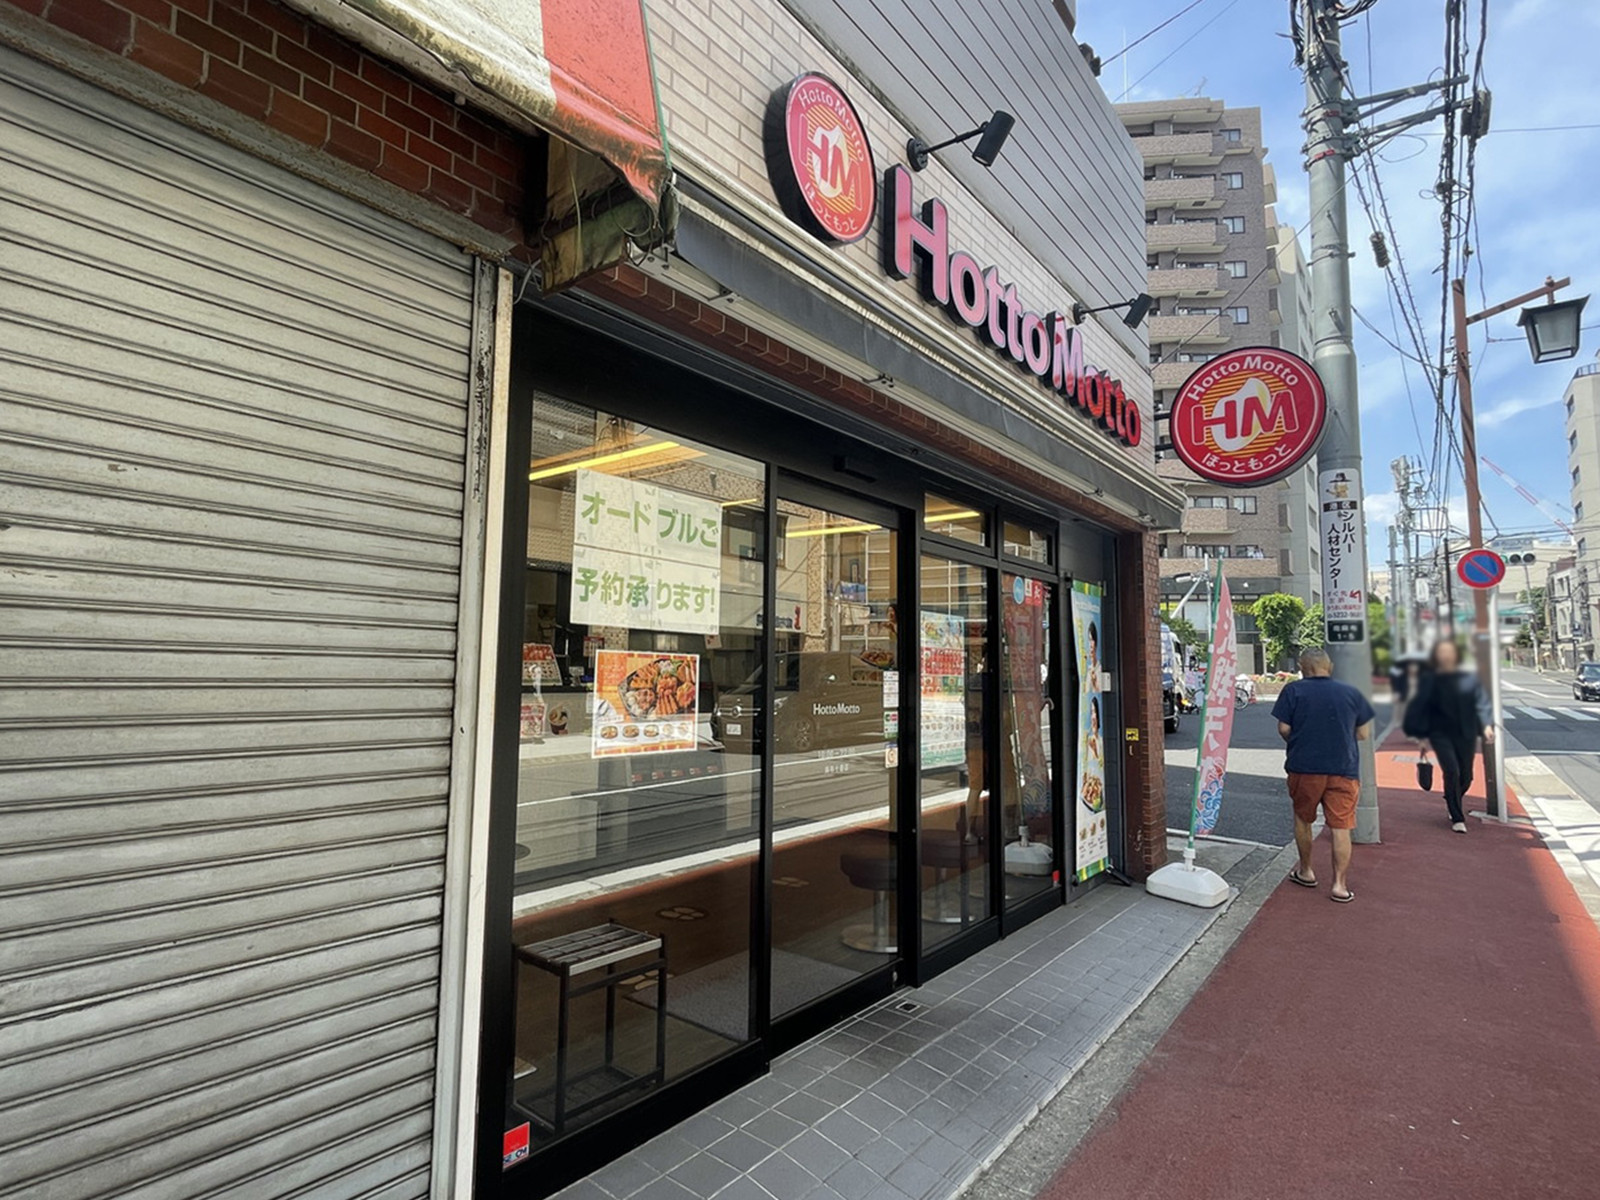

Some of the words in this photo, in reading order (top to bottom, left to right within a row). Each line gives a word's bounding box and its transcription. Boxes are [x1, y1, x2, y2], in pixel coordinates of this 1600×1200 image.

[892, 163, 1141, 447] HottoMotto
[1202, 443, 1291, 473] ほっともっと
[581, 491, 719, 548] オードブルご
[1342, 511, 1355, 553] シルバー
[1328, 523, 1341, 589] 人材センター
